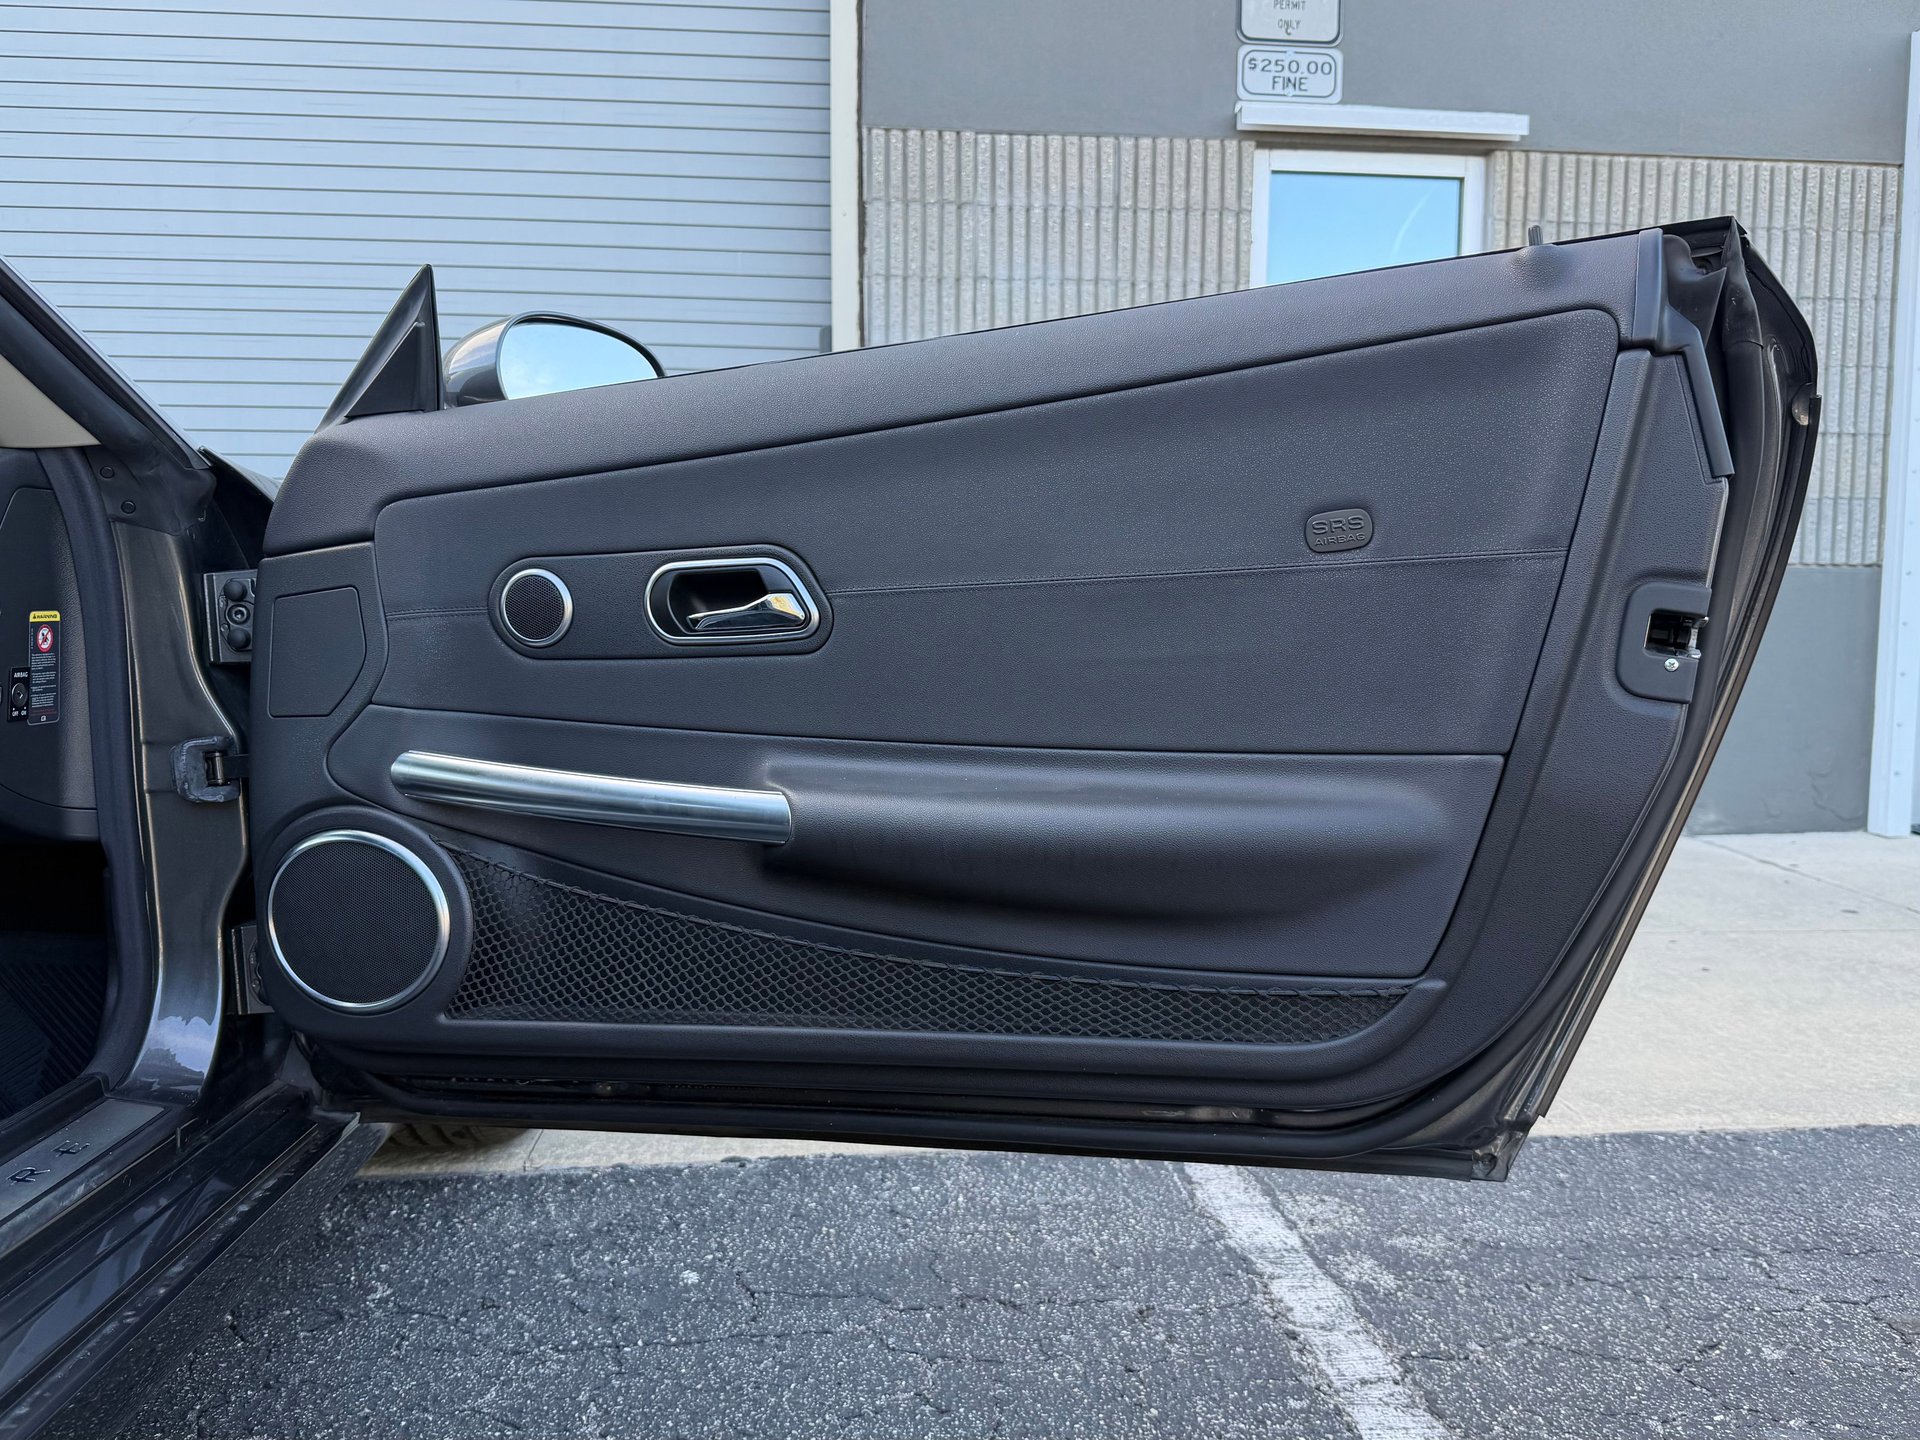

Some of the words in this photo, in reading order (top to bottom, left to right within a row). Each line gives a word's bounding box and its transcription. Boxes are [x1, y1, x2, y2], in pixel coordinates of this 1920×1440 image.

[1273, 0, 1306, 10] PERMIT
[1277, 18, 1302, 30] ONLY
[1248, 57, 1332, 75] $250.00
[1272, 75, 1308, 91] FINE
[1312, 515, 1364, 535] SRS
[1314, 532, 1366, 547] AIRBAG
